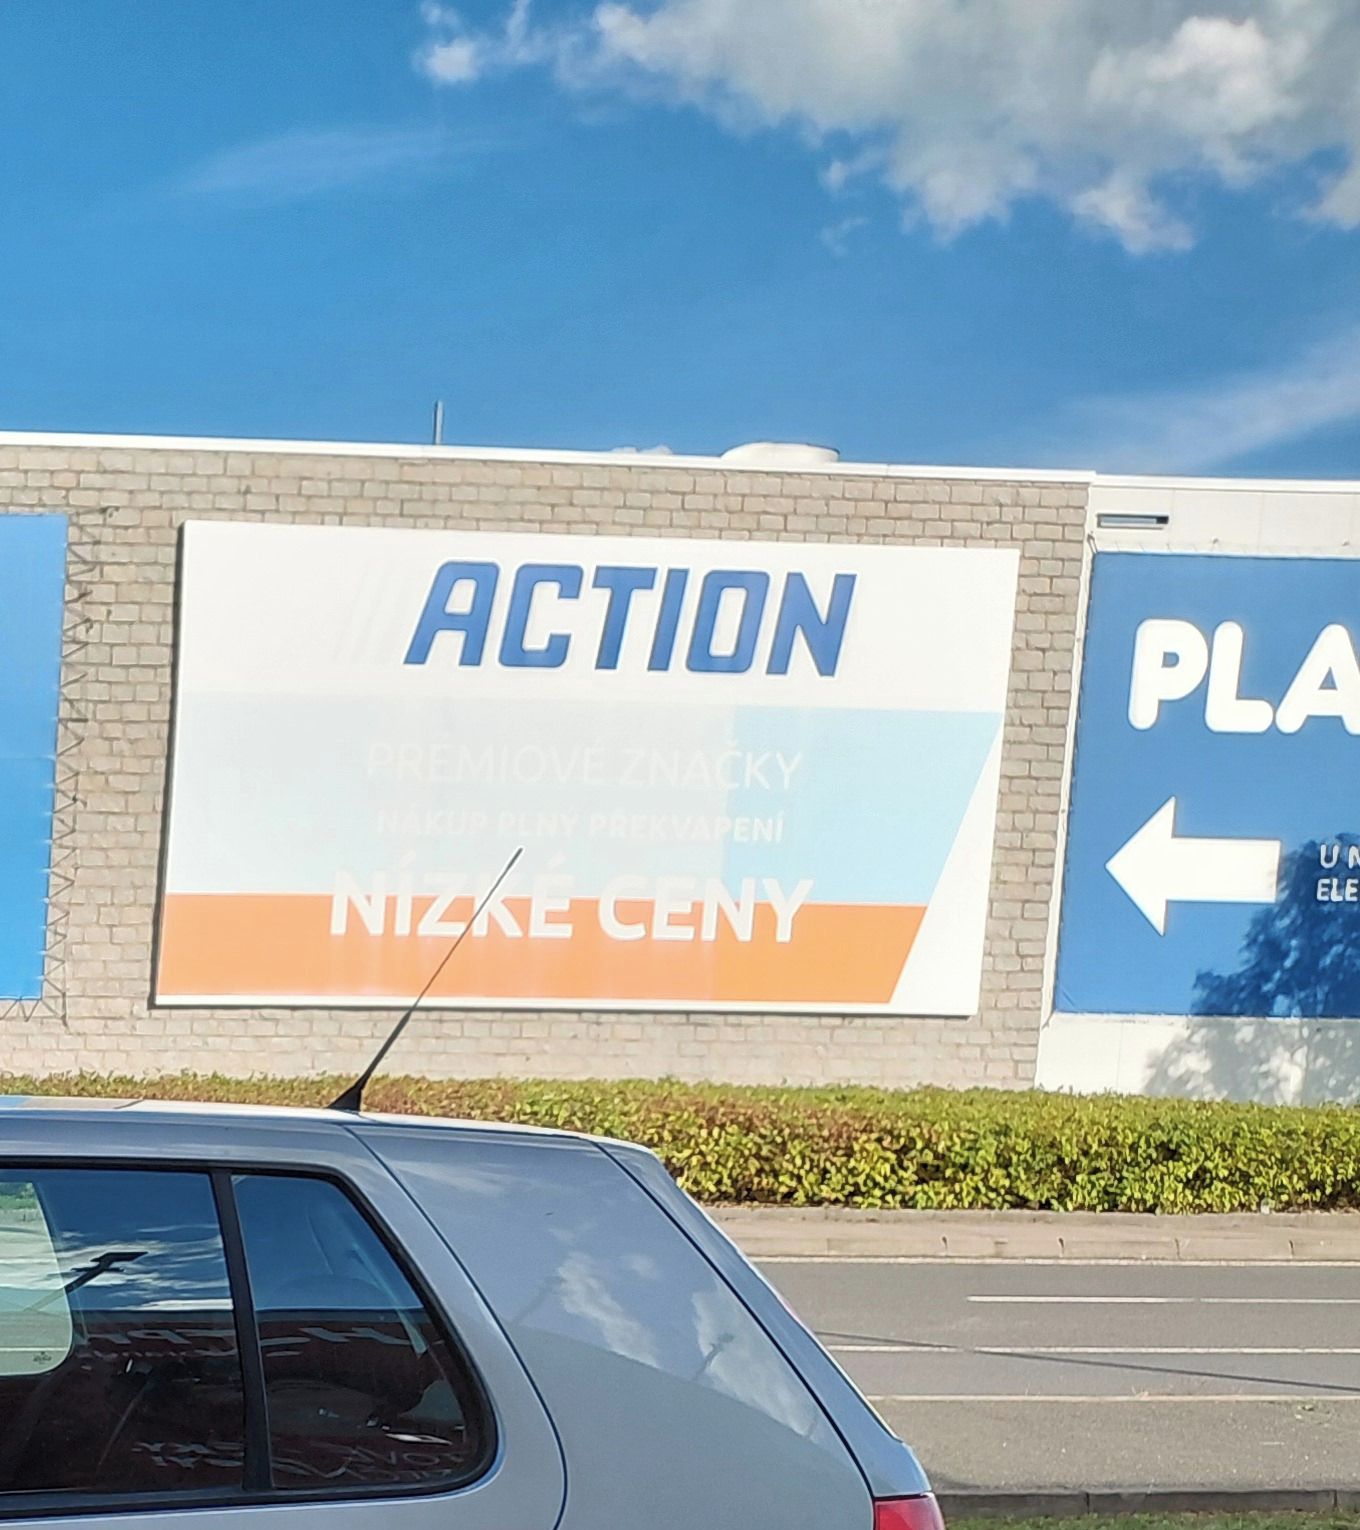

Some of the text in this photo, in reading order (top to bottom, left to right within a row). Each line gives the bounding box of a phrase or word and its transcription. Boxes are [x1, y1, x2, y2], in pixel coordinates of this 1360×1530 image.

[403, 561, 858, 676] ACTION
[1128, 618, 1360, 736] PLA
[620, 738, 804, 791] ZNAČKY
[330, 851, 815, 943] NÍZKÉ CENY
